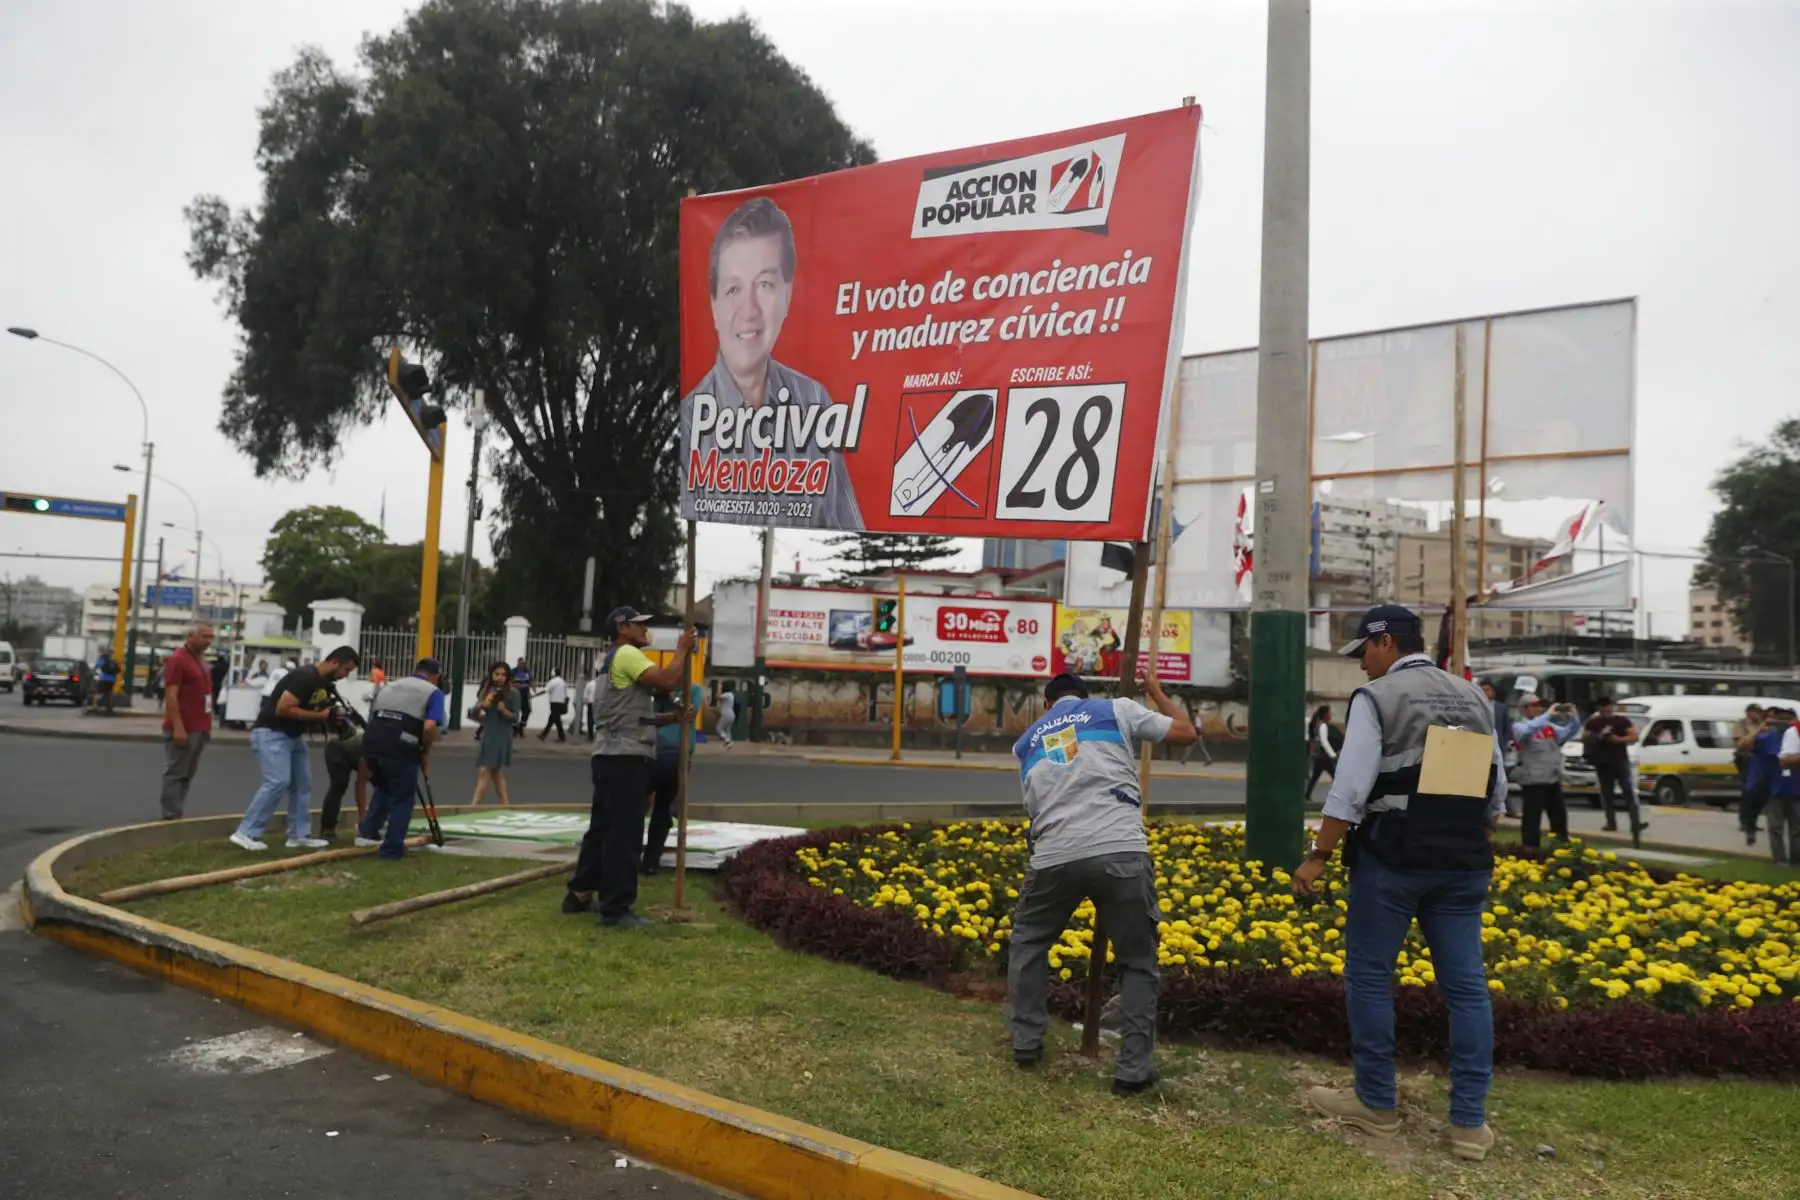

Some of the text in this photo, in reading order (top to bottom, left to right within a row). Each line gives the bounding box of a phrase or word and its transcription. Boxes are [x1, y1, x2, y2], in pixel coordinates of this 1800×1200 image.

[945, 169, 1037, 202] ACCION
[922, 193, 1037, 227] POPULAR
[835, 249, 1153, 315] El voto de conciencia
[850, 328, 867, 360] y
[871, 314, 994, 352] madurez
[1000, 302, 1096, 341] cívica
[904, 368, 963, 388] MARCA ASÍ:
[1010, 362, 1094, 383] ESCRIBE ASÍ:
[690, 384, 868, 450] Percival
[1005, 394, 1113, 511] 28
[687, 447, 831, 495] Mendoza
[694, 499, 755, 515] CONGRESISTA
[756, 501, 780, 516] 2020
[787, 502, 814, 518] 2021
[944, 612, 969, 631] 30
[969, 618, 1001, 632] Mbps
[1016, 618, 1039, 635] 80
